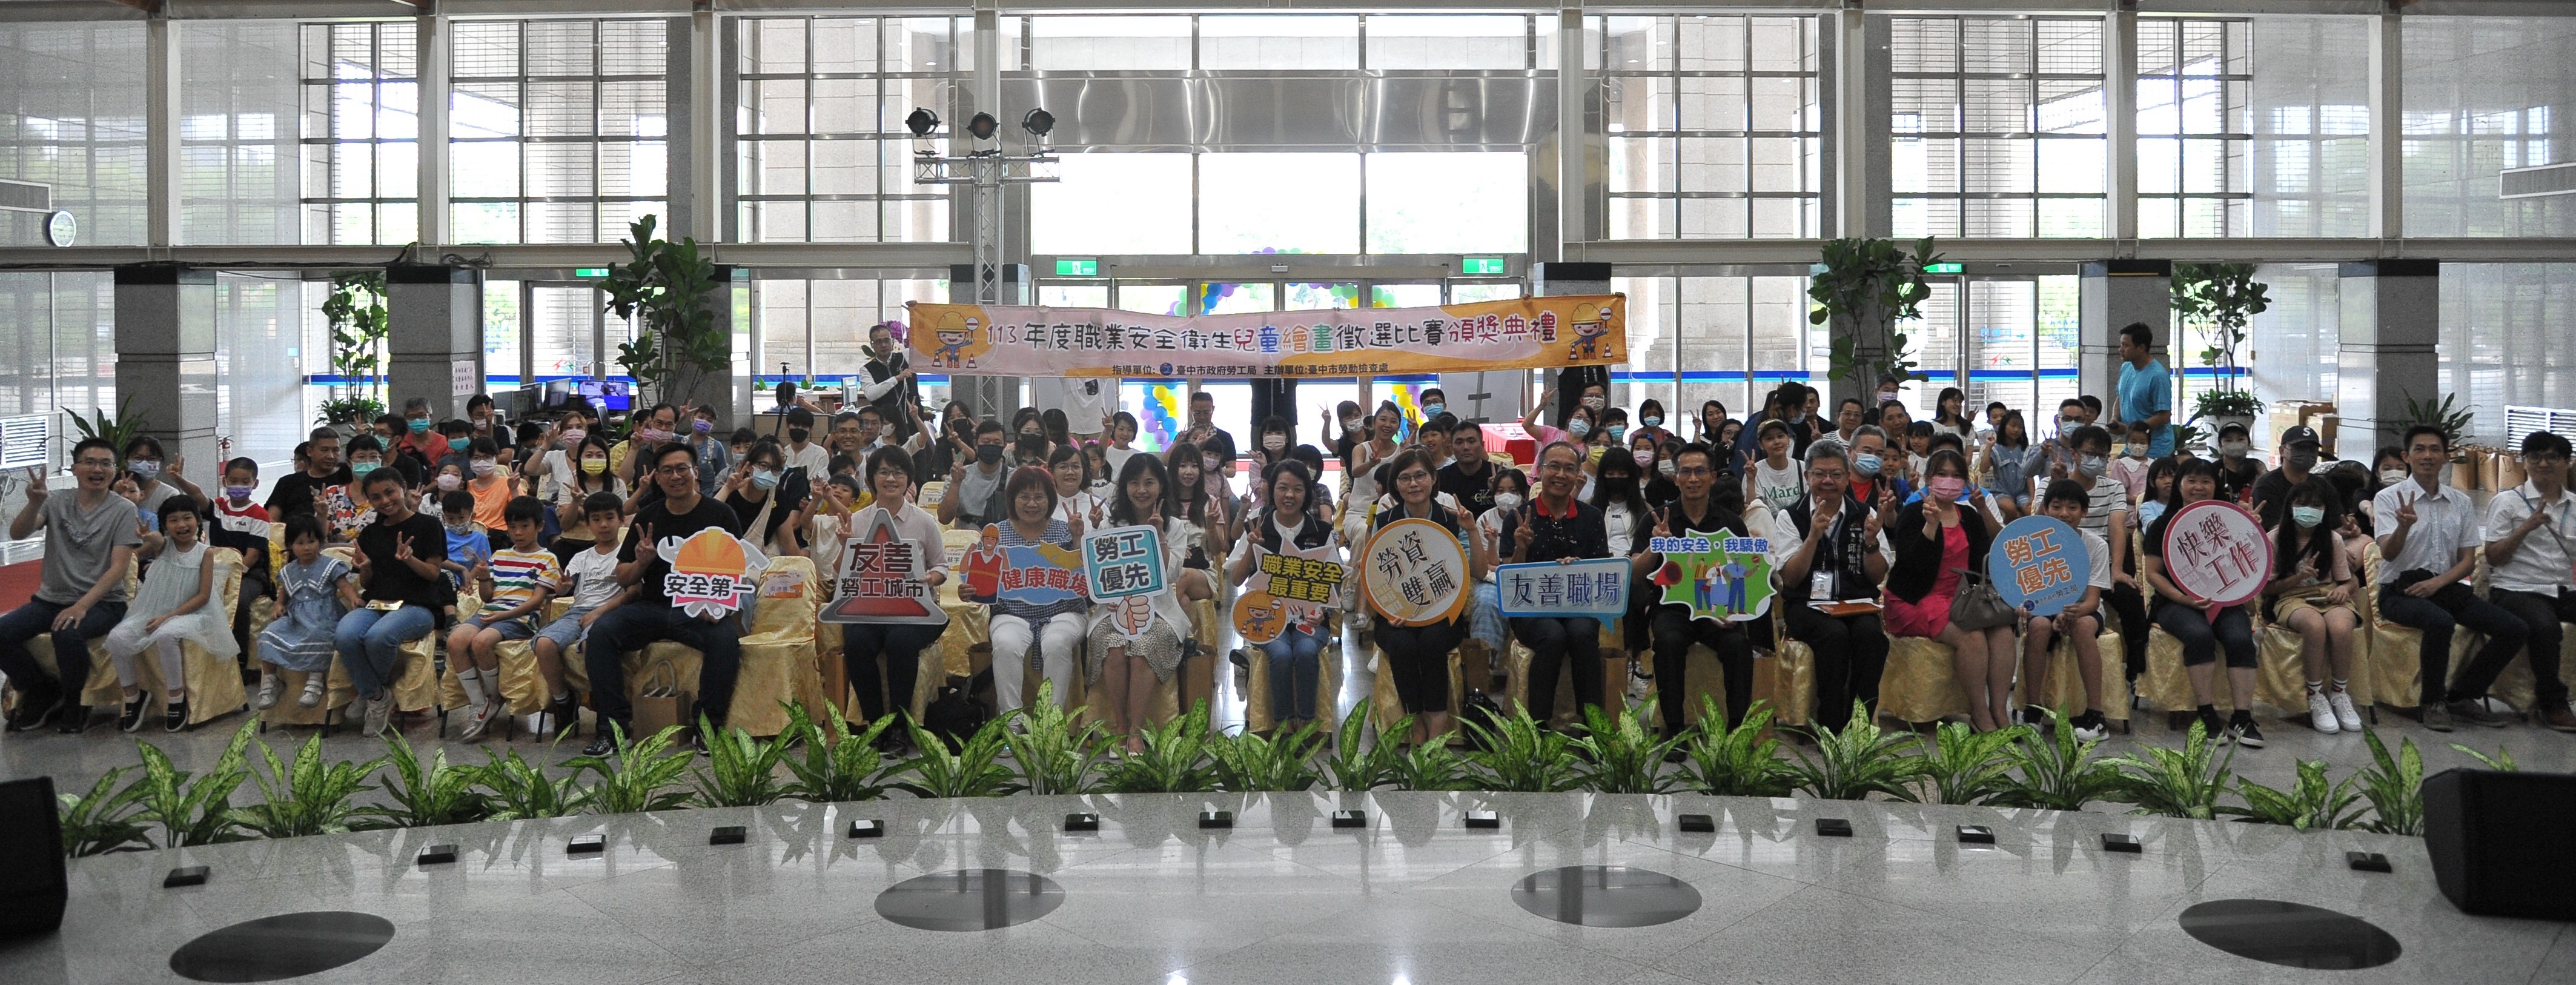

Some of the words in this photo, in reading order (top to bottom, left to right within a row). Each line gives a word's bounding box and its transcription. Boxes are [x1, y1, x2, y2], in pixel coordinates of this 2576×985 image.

[987, 325, 1017, 343] 113
[1024, 311, 1556, 353] 年度職業安全衛生兒童繪畫徵選比賽頒獎典禮
[1176, 365, 1257, 376] 臺中市政府勞工局
[2302, 427, 2311, 436] S
[1094, 533, 1146, 562] 勞工
[2004, 528, 2061, 567] 勞工
[2177, 513, 2231, 568] 快樂
[849, 543, 913, 573] 友善
[1261, 554, 1343, 583] 職業安全
[1376, 531, 1428, 586] 勞資
[2205, 541, 2258, 594] 工作
[666, 575, 753, 597] 安全第一
[841, 577, 924, 598] 勞工城市
[1001, 566, 1089, 597] 健康職場
[1099, 563, 1150, 592] 優先
[1268, 576, 1331, 603] 最重要
[1401, 560, 1455, 615] 雙贏
[1509, 572, 1619, 605] 友善職場
[2017, 557, 2071, 595] 優先
